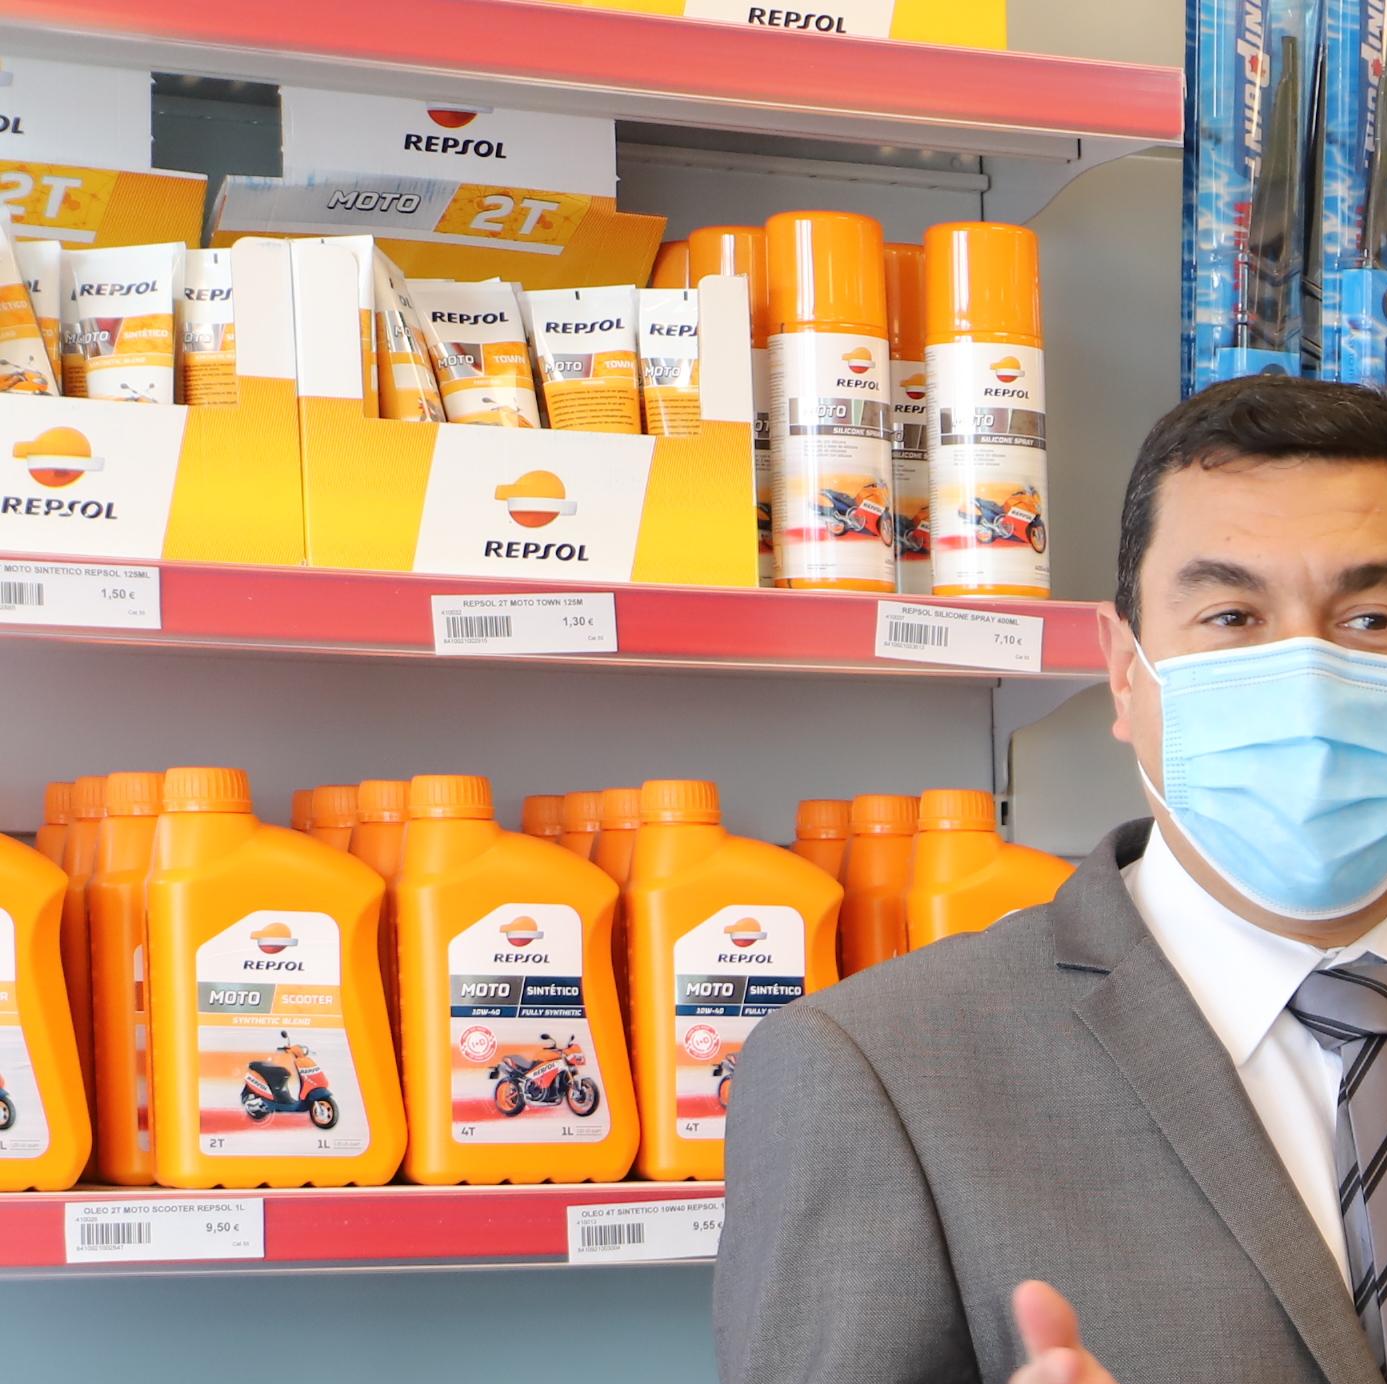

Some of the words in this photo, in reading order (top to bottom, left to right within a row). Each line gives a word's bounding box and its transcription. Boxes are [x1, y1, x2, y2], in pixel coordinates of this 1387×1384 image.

[748, 7, 847, 34] REPSOL
[404, 134, 507, 160] REPSOL
[327, 189, 422, 214] MOTO
[469, 195, 562, 236] 2T
[80, 280, 158, 296] REPSOL
[432, 311, 509, 325] REPSOL
[545, 318, 625, 334] REPSOL
[438, 355, 474, 367] MOTO
[837, 378, 879, 390] REPSOL
[984, 388, 1029, 399] REPSOL
[1, 495, 118, 519] REPSOL
[484, 540, 589, 561] REPSOL
[4, 564, 31, 573] MOTO
[35, 567, 82, 576] SINTETICO
[84, 569, 121, 578] REPSOL
[101, 588, 126, 600] 1,50
[902, 607, 931, 616] REPSOL
[935, 610, 968, 621] SILICONE
[971, 615, 994, 623] SPRAY
[563, 617, 585, 626] 1,30
[994, 634, 1015, 645] 7,10
[494, 953, 549, 963] REPSOL
[718, 954, 773, 963] REPSOL
[244, 960, 304, 972] REPSOL
[461, 983, 510, 997] MOTO
[527, 984, 579, 995] SINTÉTICO
[686, 983, 734, 997] MOTO
[750, 983, 801, 995] SINTÉTICO
[209, 991, 261, 1006] MOTO
[282, 994, 333, 1004] SCOOTER
[462, 1127, 475, 1136] 4T
[562, 1127, 573, 1135] 1L
[686, 1123, 699, 1131] 4T
[210, 1139, 225, 1148] 2T
[318, 1140, 330, 1148] 1L
[618, 1207, 658, 1216] SINTETICO
[206, 1223, 230, 1233] 9,50
[693, 1221, 715, 1231] 9,55
